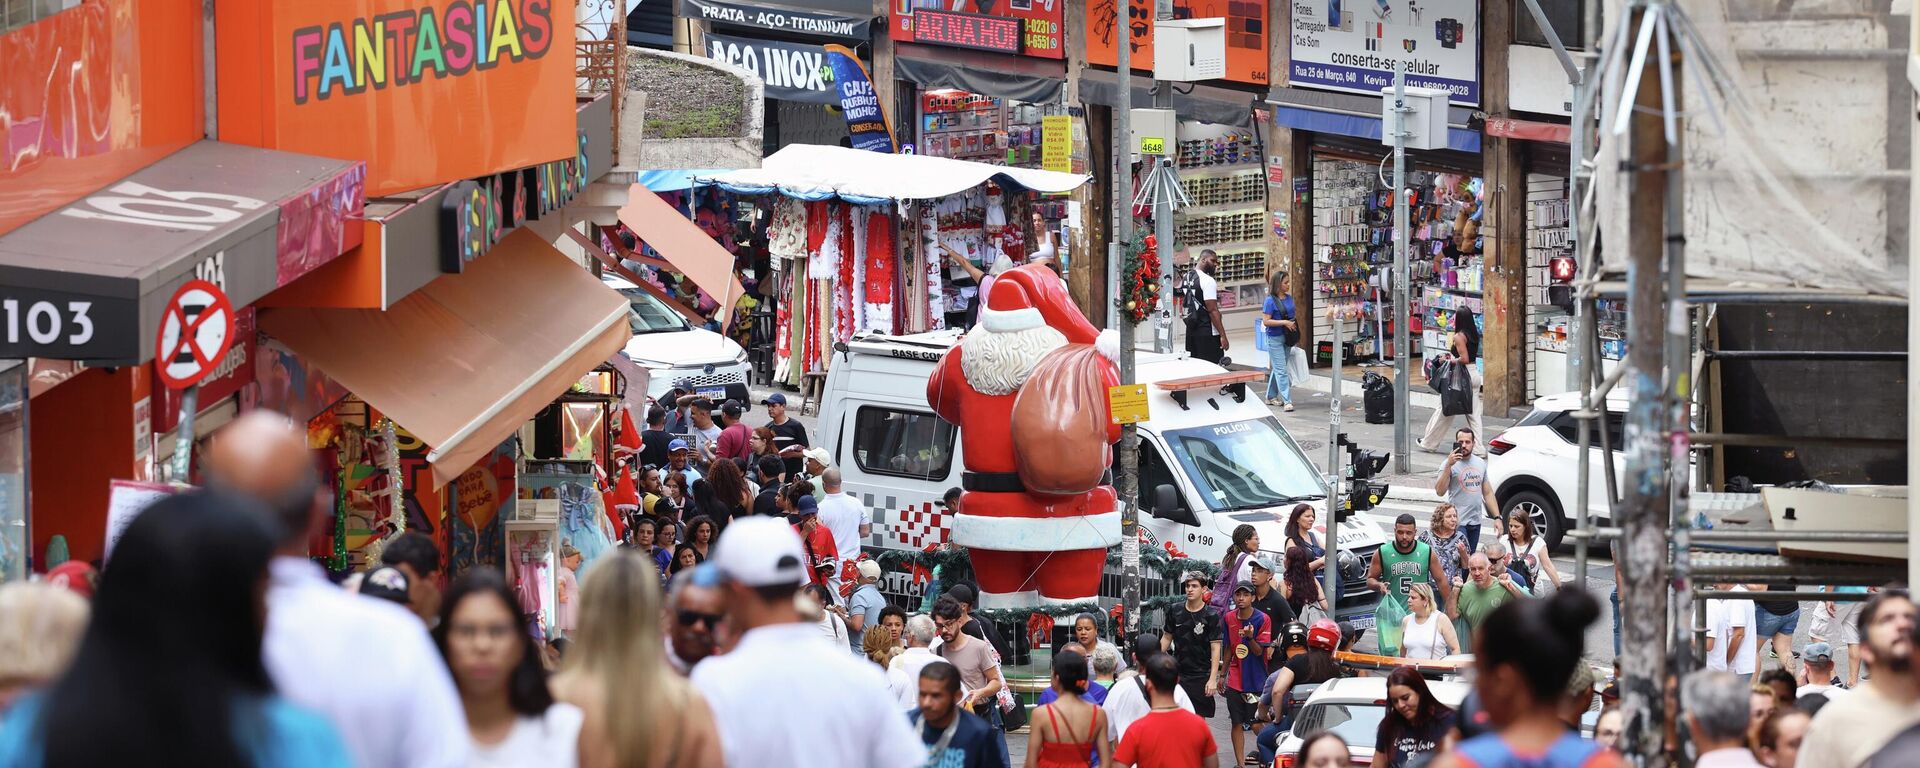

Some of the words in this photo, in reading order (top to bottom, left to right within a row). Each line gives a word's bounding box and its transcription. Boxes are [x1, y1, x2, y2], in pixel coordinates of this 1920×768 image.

[702, 5, 746, 22] PRATA
[947, 16, 977, 46] NA
[1307, 36, 1320, 48] Som
[294, 0, 553, 103] FANTASIAS
[764, 48, 825, 91] INOX
[1331, 53, 1396, 70] conserta-se
[1404, 58, 1440, 75] celular
[1251, 72, 1266, 81] 644
[1295, 65, 1308, 77] Rua
[1308, 69, 1316, 78] 25
[1316, 71, 1324, 79] de
[1325, 71, 1344, 83] Março,
[1345, 73, 1357, 83] 640
[1363, 74, 1387, 86] Kevin
[1142, 143, 1163, 152] 4648
[3, 299, 94, 345] 103
[891, 349, 919, 359] BASE
[1213, 423, 1252, 436] POLÍCIA
[1197, 535, 1214, 546] 190
[1336, 532, 1369, 544] OLÍCIA
[1391, 561, 1422, 577] BOSTON
[878, 575, 925, 597] OLÍCI
[1400, 576, 1413, 595] 5
